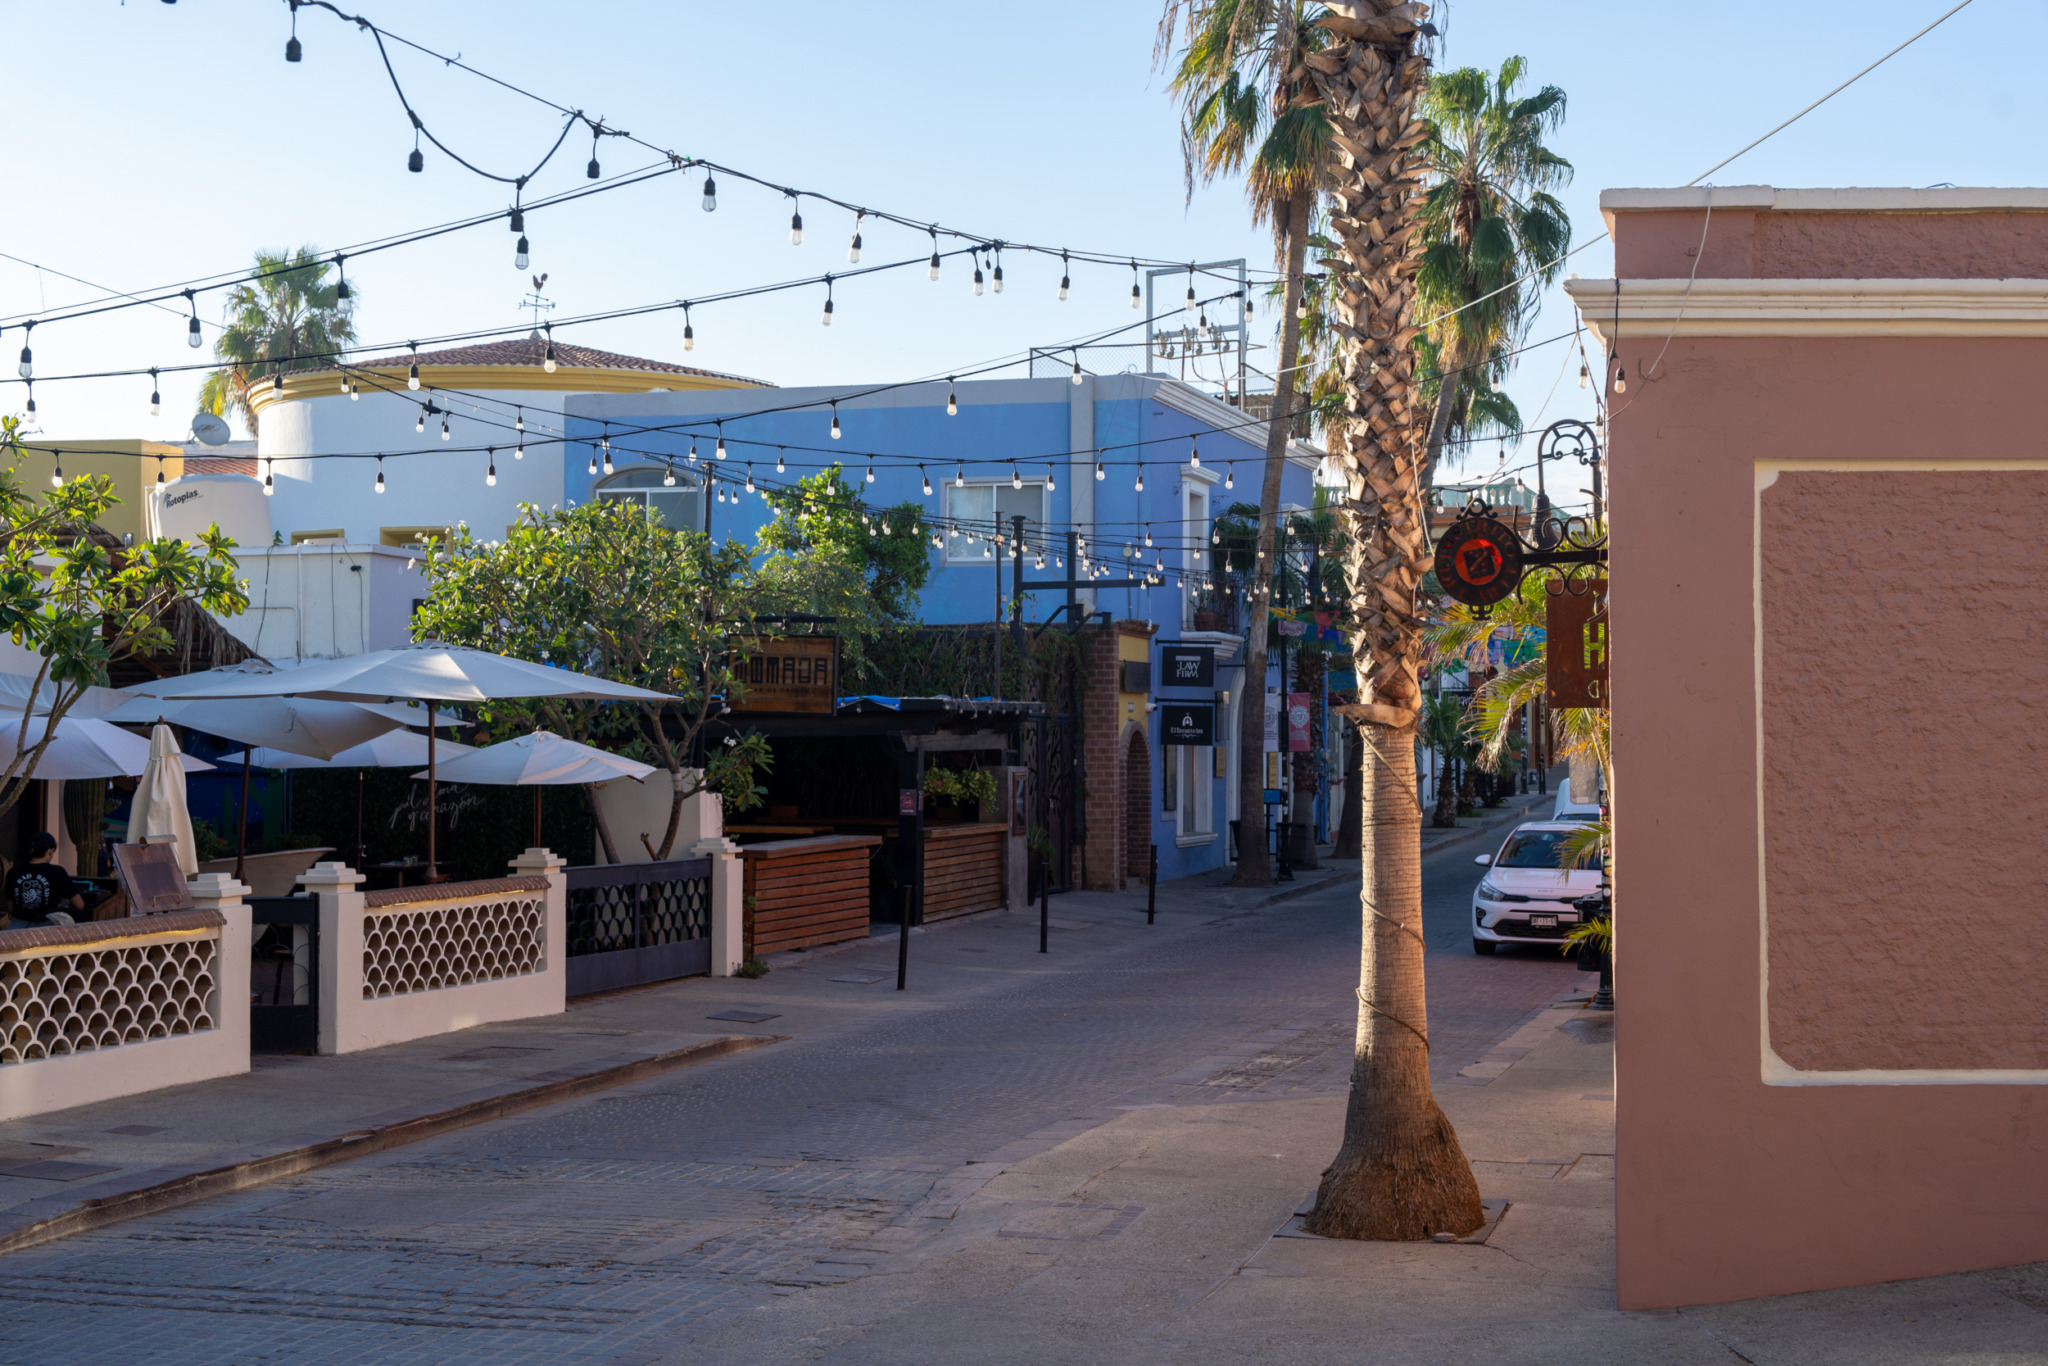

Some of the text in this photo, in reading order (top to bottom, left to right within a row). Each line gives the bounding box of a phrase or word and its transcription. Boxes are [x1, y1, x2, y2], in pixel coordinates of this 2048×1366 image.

[165, 490, 199, 509] Rotoplas
[1179, 661, 1201, 671] LAW
[1176, 669, 1199, 679] FIRM
[16, 873, 32, 885] BAD
